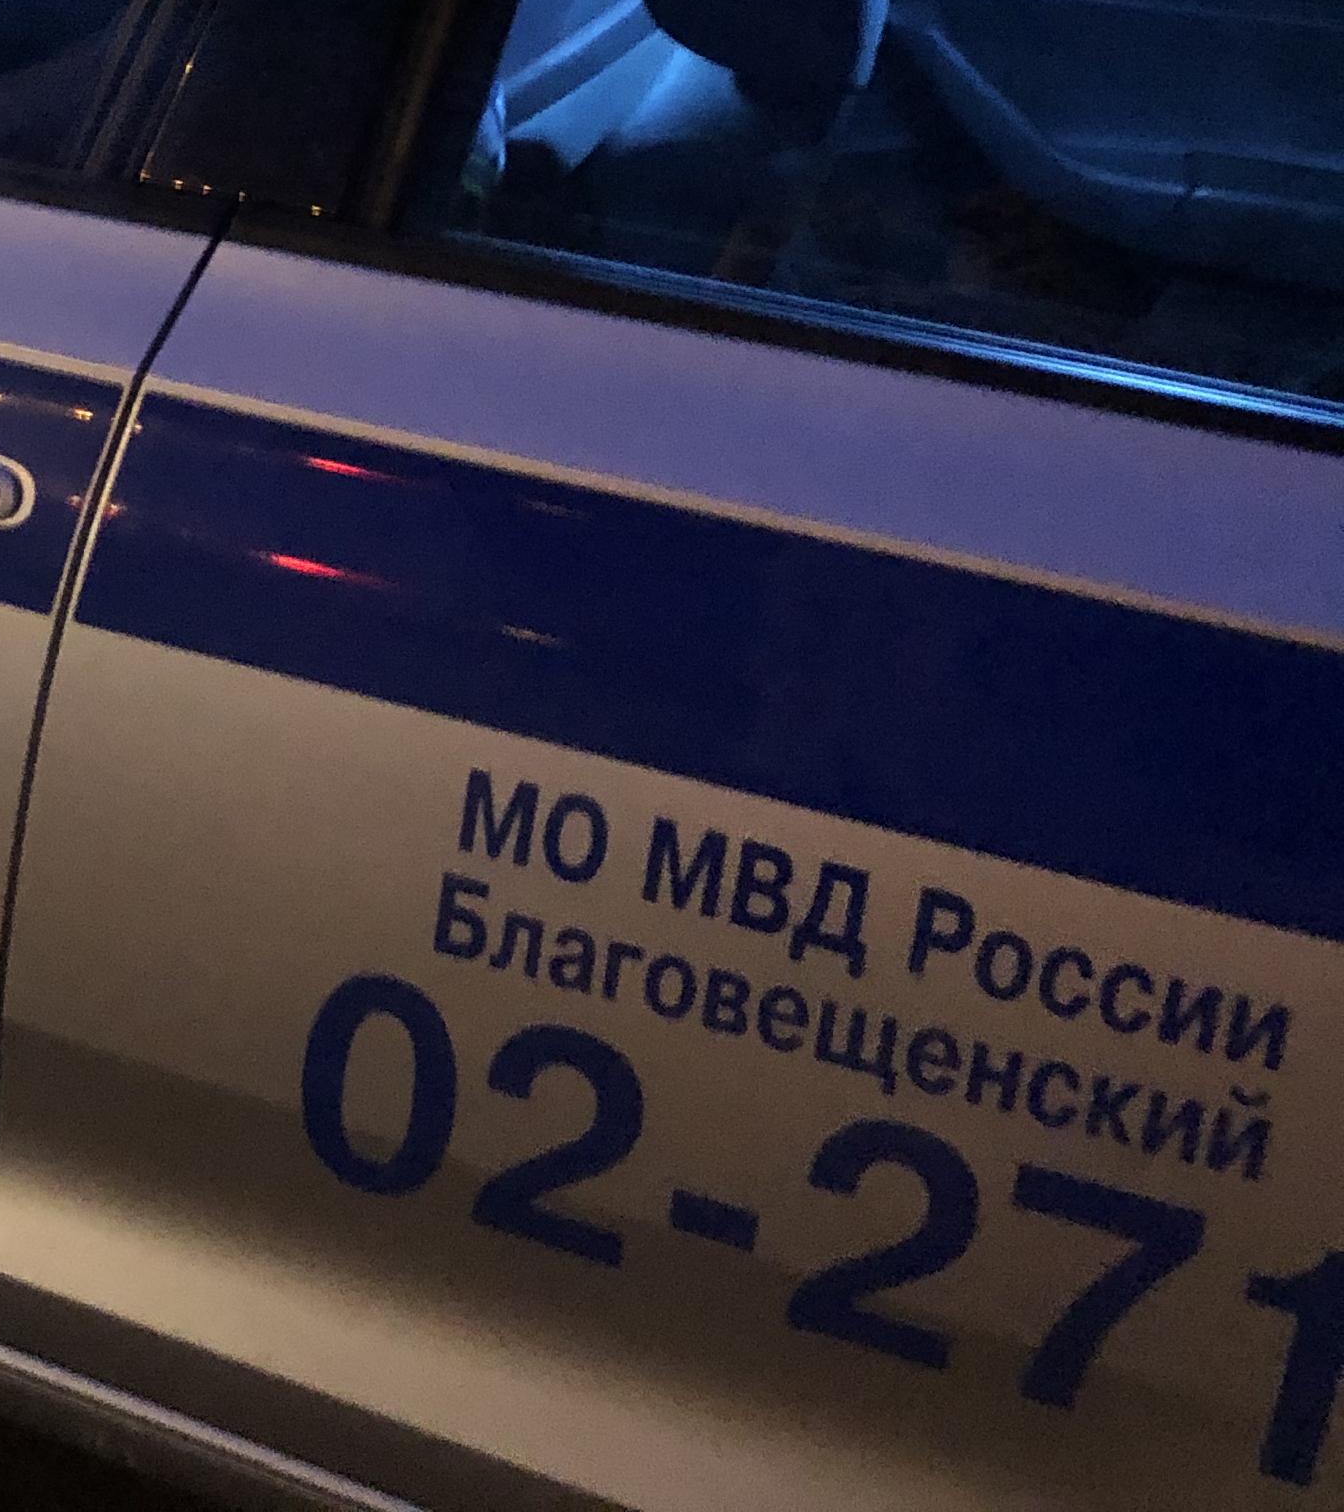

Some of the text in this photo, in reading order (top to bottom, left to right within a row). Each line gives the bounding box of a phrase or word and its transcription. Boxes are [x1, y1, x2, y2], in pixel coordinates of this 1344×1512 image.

[433, 872, 1272, 1182] Благовещенский
[459, 769, 1292, 1071] МО МВД России
